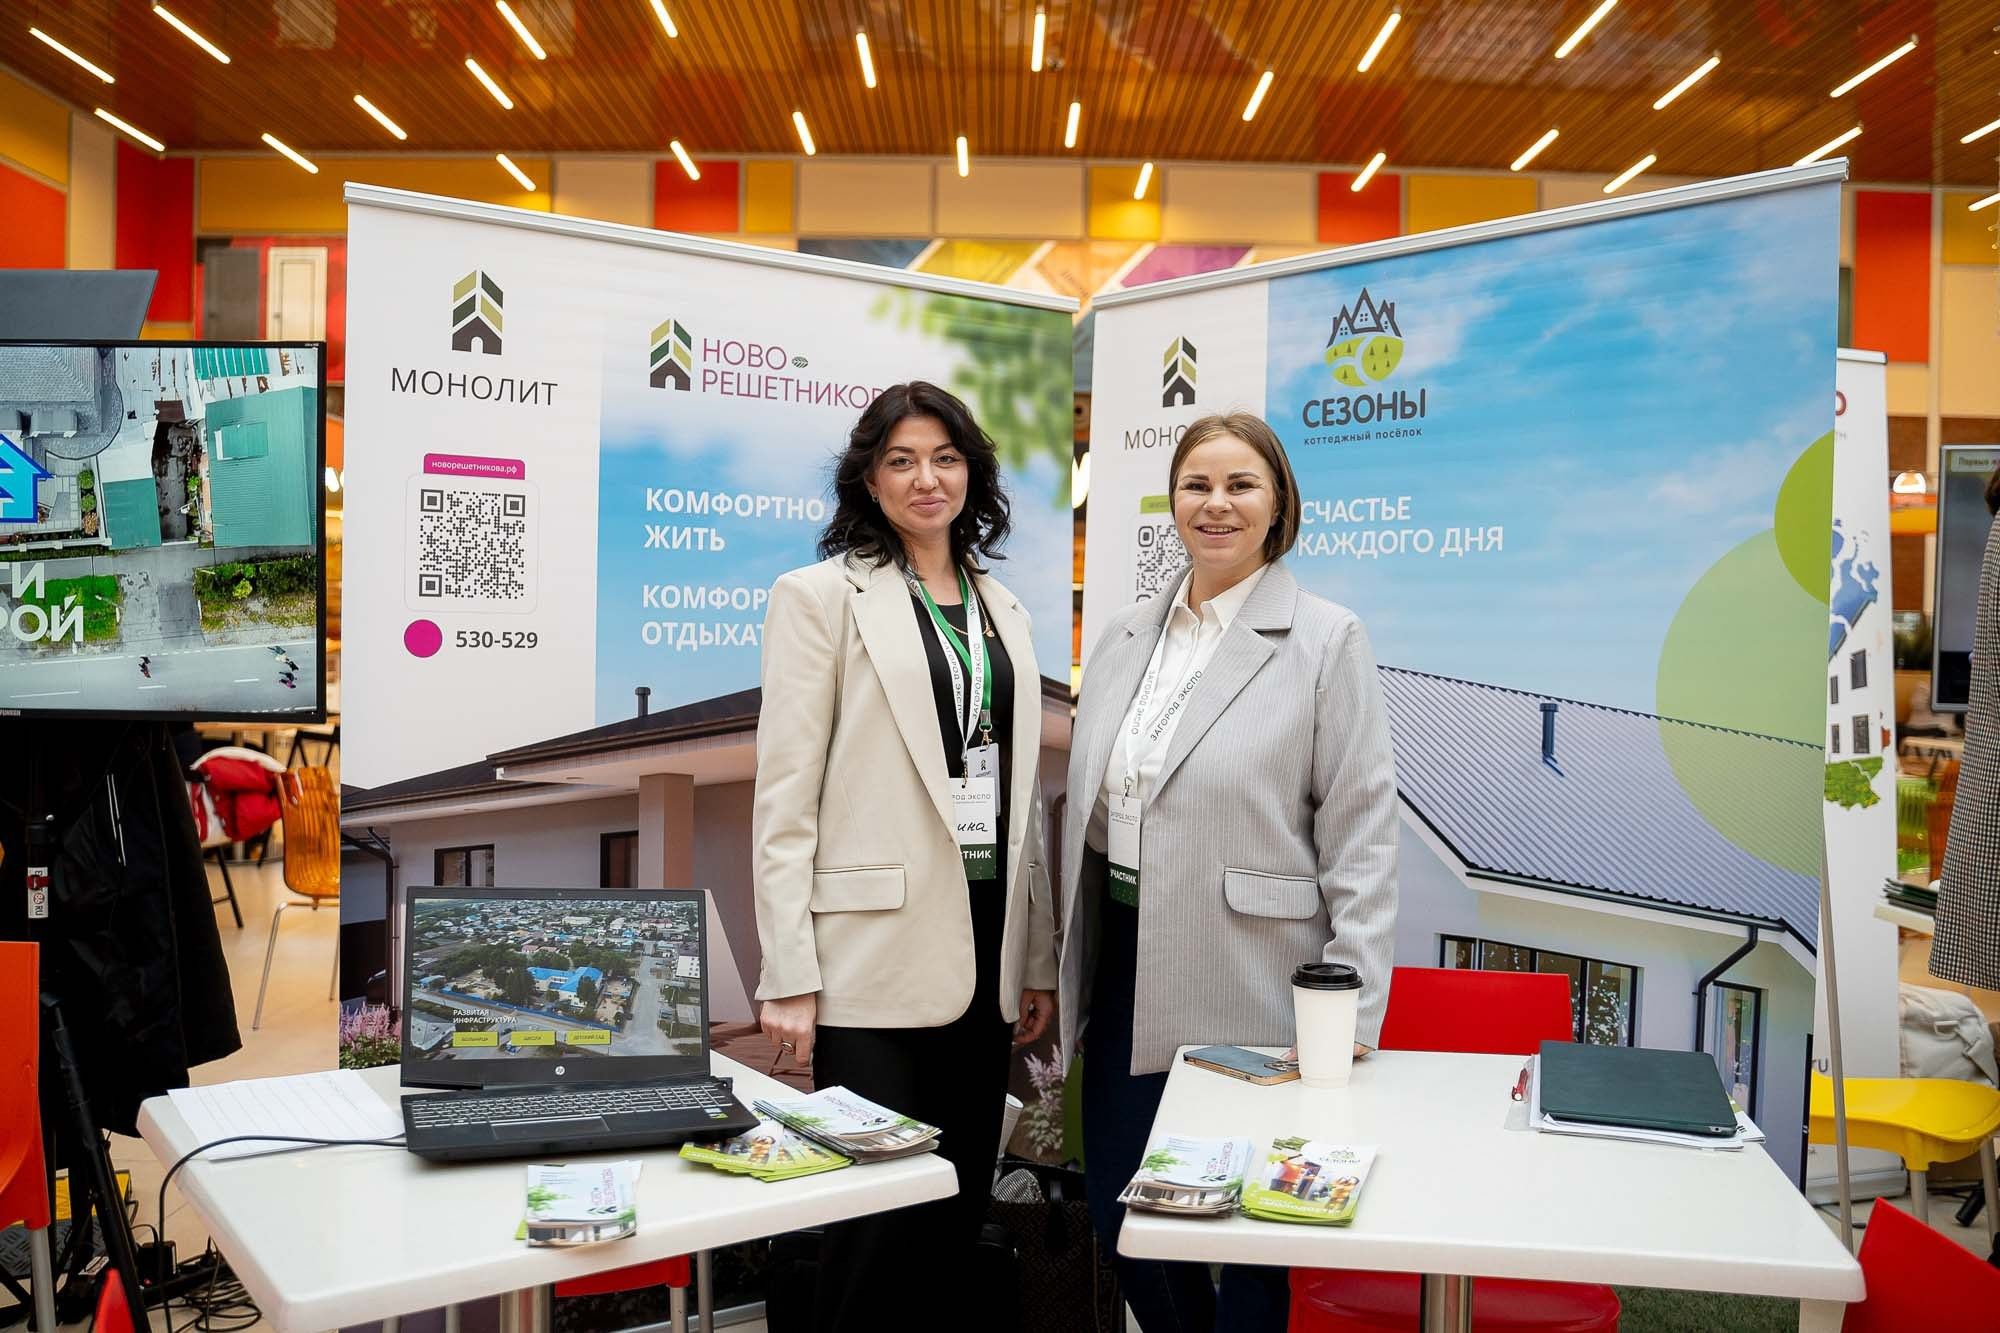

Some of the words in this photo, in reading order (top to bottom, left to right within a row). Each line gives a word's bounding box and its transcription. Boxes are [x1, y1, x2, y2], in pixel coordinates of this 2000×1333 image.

[702, 337, 788, 371] НОВО
[391, 367, 558, 406] МОНОЛИТ
[1302, 388, 1426, 429] СЕЗОНЫ
[1303, 432, 1371, 446] коттеджный
[1375, 428, 1423, 440] посёлок
[431, 460, 518, 475] новорешетникова.рф
[645, 487, 826, 522] КОМФОРТНО
[1299, 495, 1412, 525] СЧАСТЬЕ
[643, 524, 726, 552] ЖИТЬ
[1298, 528, 1435, 560] КАЖДОГО
[1439, 525, 1504, 558] ДНЯ
[642, 585, 772, 611] КОМФОР
[455, 630, 538, 649] 530-529
[1150, 701, 1180, 742] ЗАГОРОД
[1177, 670, 1203, 702] ЭКСПО
[961, 849, 992, 860] ТНИК
[452, 1008, 490, 1017] РАЗВИТАЯ
[452, 1016, 517, 1025] ИНФРАСТРУКТУРА
